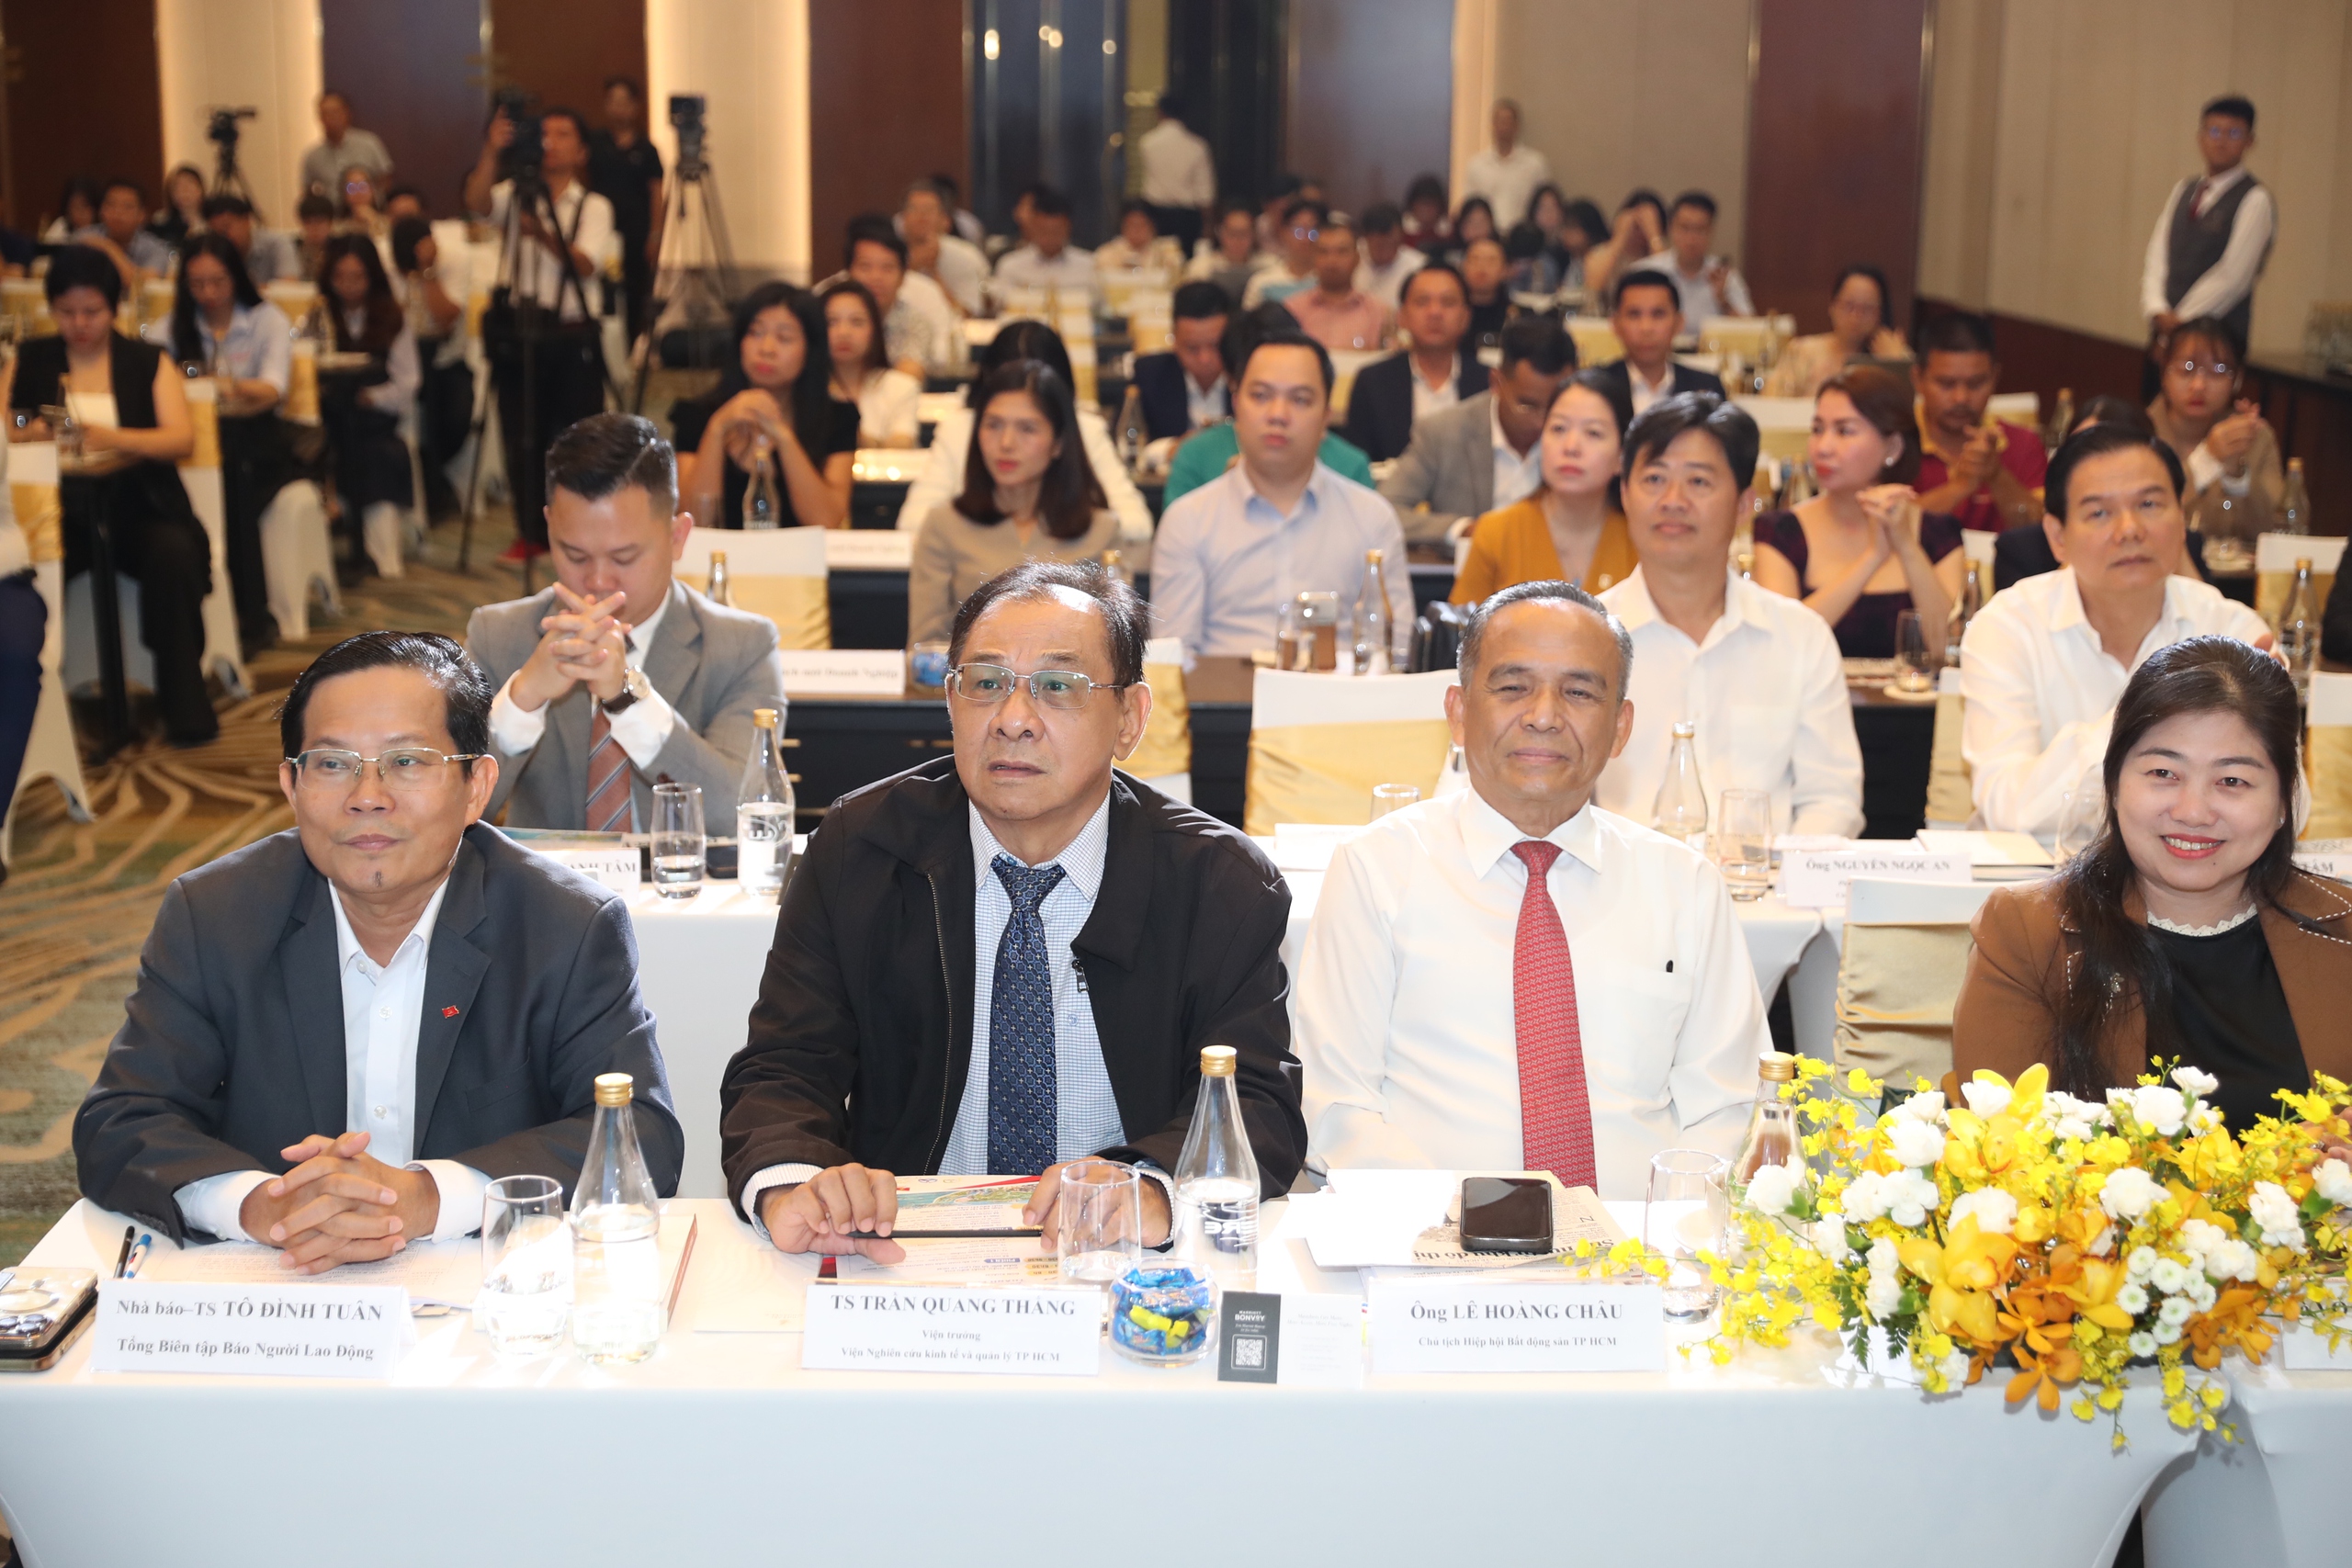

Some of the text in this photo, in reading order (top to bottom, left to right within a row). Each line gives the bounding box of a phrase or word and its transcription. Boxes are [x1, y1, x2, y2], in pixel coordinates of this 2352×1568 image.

[117, 1300, 150, 1314] Nhà
[223, 1296, 254, 1317] TÔ
[259, 1297, 316, 1319] ĐÌNH
[322, 1299, 383, 1321] TUÂN
[830, 1294, 855, 1310] TS
[922, 1296, 996, 1315] QUANG
[1410, 1299, 1623, 1324] Ông LÊ HOÀNG CHÂU
[922, 1329, 944, 1340] Viện
[1442, 1337, 1460, 1348] tịch
[1463, 1337, 1487, 1348] Hiệp
[1488, 1337, 1504, 1348] hội
[1507, 1335, 1523, 1347] Bất
[1571, 1337, 1587, 1347] TP
[1589, 1337, 1617, 1347] HCM
[117, 1335, 375, 1361] Tổng Biên tập Báo Người Lao Động
[841, 1347, 864, 1359] Viện
[866, 1348, 900, 1359] Nghiên
[903, 1348, 922, 1359] cứu
[924, 1348, 946, 1359] kinh
[961, 1349, 973, 1359] và
[1002, 1350, 1012, 1362] lý
[1014, 1351, 1029, 1361] TP
[1032, 1352, 1059, 1361] HCM
